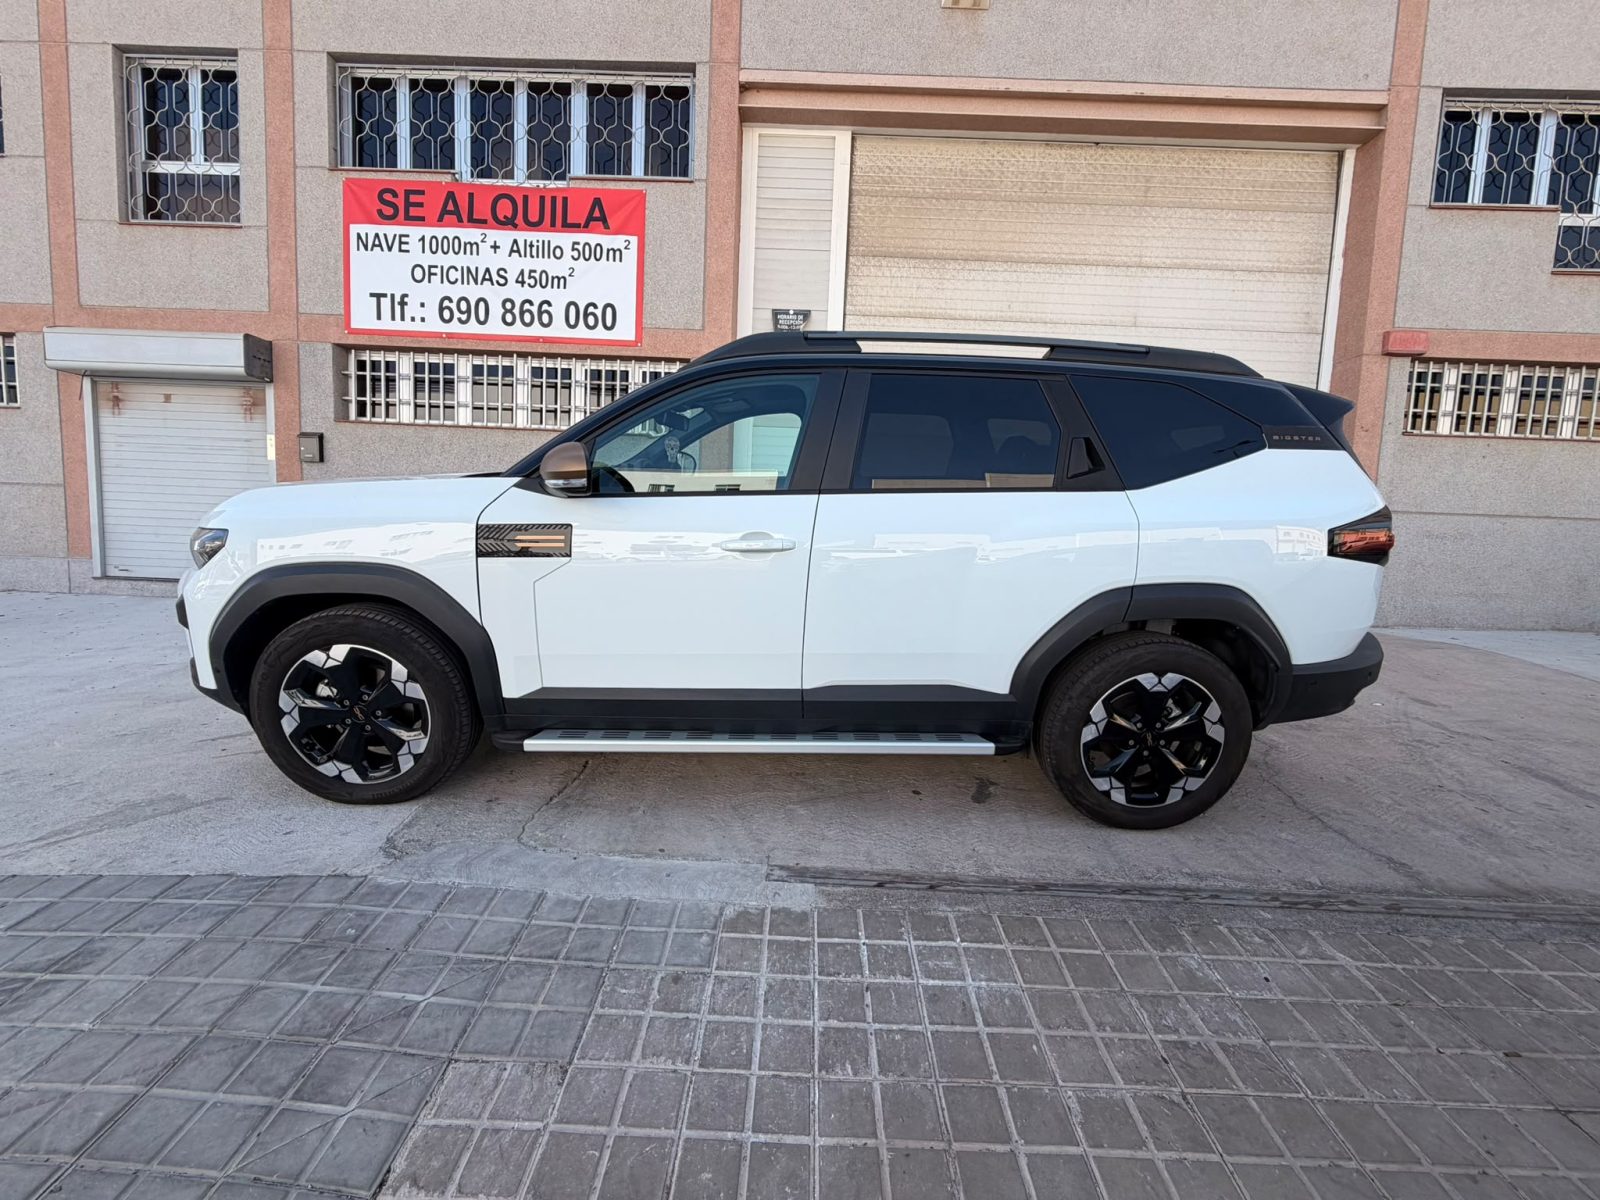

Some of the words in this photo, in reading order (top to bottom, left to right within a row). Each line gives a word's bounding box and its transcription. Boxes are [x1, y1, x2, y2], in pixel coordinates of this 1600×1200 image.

[376, 188, 426, 222] SE
[437, 190, 611, 230] ALQUILA
[356, 232, 411, 253] NAVE
[507, 238, 564, 260] Altillo
[410, 263, 509, 287] OFICINAS
[515, 266, 575, 290] 450m²
[369, 292, 426, 323] Tlf.:
[438, 295, 490, 326] 690
[501, 297, 554, 328] 866
[564, 300, 617, 331] 060
